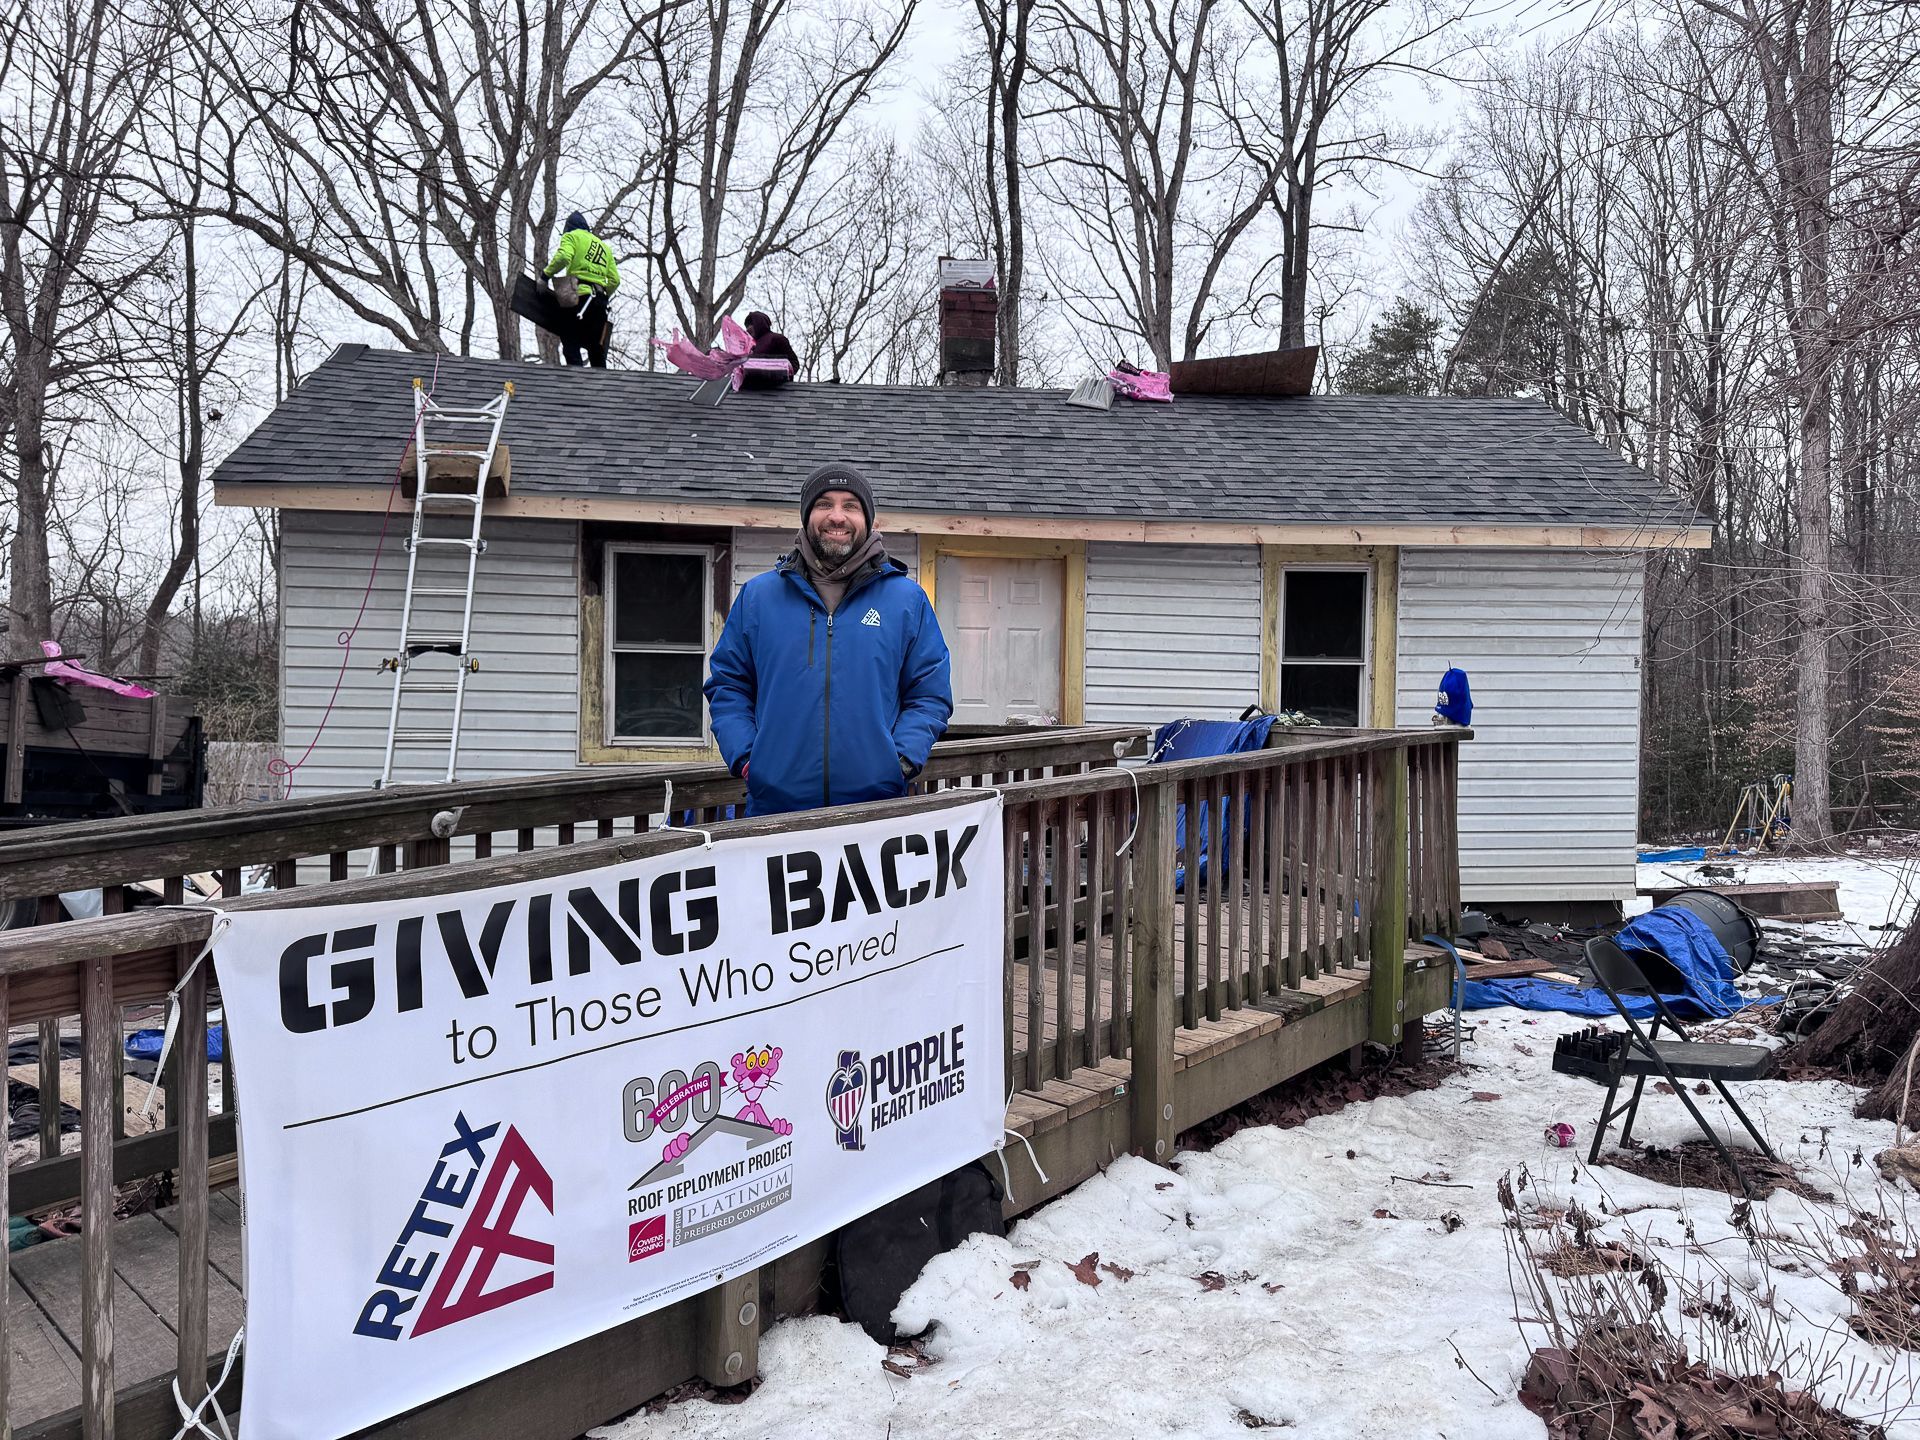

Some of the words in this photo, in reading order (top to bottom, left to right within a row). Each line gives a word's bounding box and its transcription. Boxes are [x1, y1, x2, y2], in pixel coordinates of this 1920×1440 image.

[278, 866, 719, 1034] GIVING
[766, 824, 979, 936] BACK
[446, 1019, 497, 1065] to
[515, 987, 662, 1047] Those
[679, 957, 774, 1007] Who
[789, 920, 899, 984] Served
[656, 1078, 709, 1117] CELEBRATING
[870, 1024, 965, 1104] PURPLE
[622, 1061, 721, 1143] 600
[871, 1090, 916, 1132] HEART
[919, 1070, 965, 1111] HOMES
[628, 1189, 664, 1217] ROOF
[668, 1160, 745, 1203] DEPLOYMENT
[749, 1141, 793, 1174] PROJECT
[688, 1171, 789, 1223] PLATINUM
[352, 1110, 502, 1341] RETEX
[631, 1241, 664, 1257] CORNING
[637, 1233, 664, 1248] OWENS
[684, 1216, 734, 1240] PREFERRED
[736, 1189, 790, 1219] CONTRACTOR
